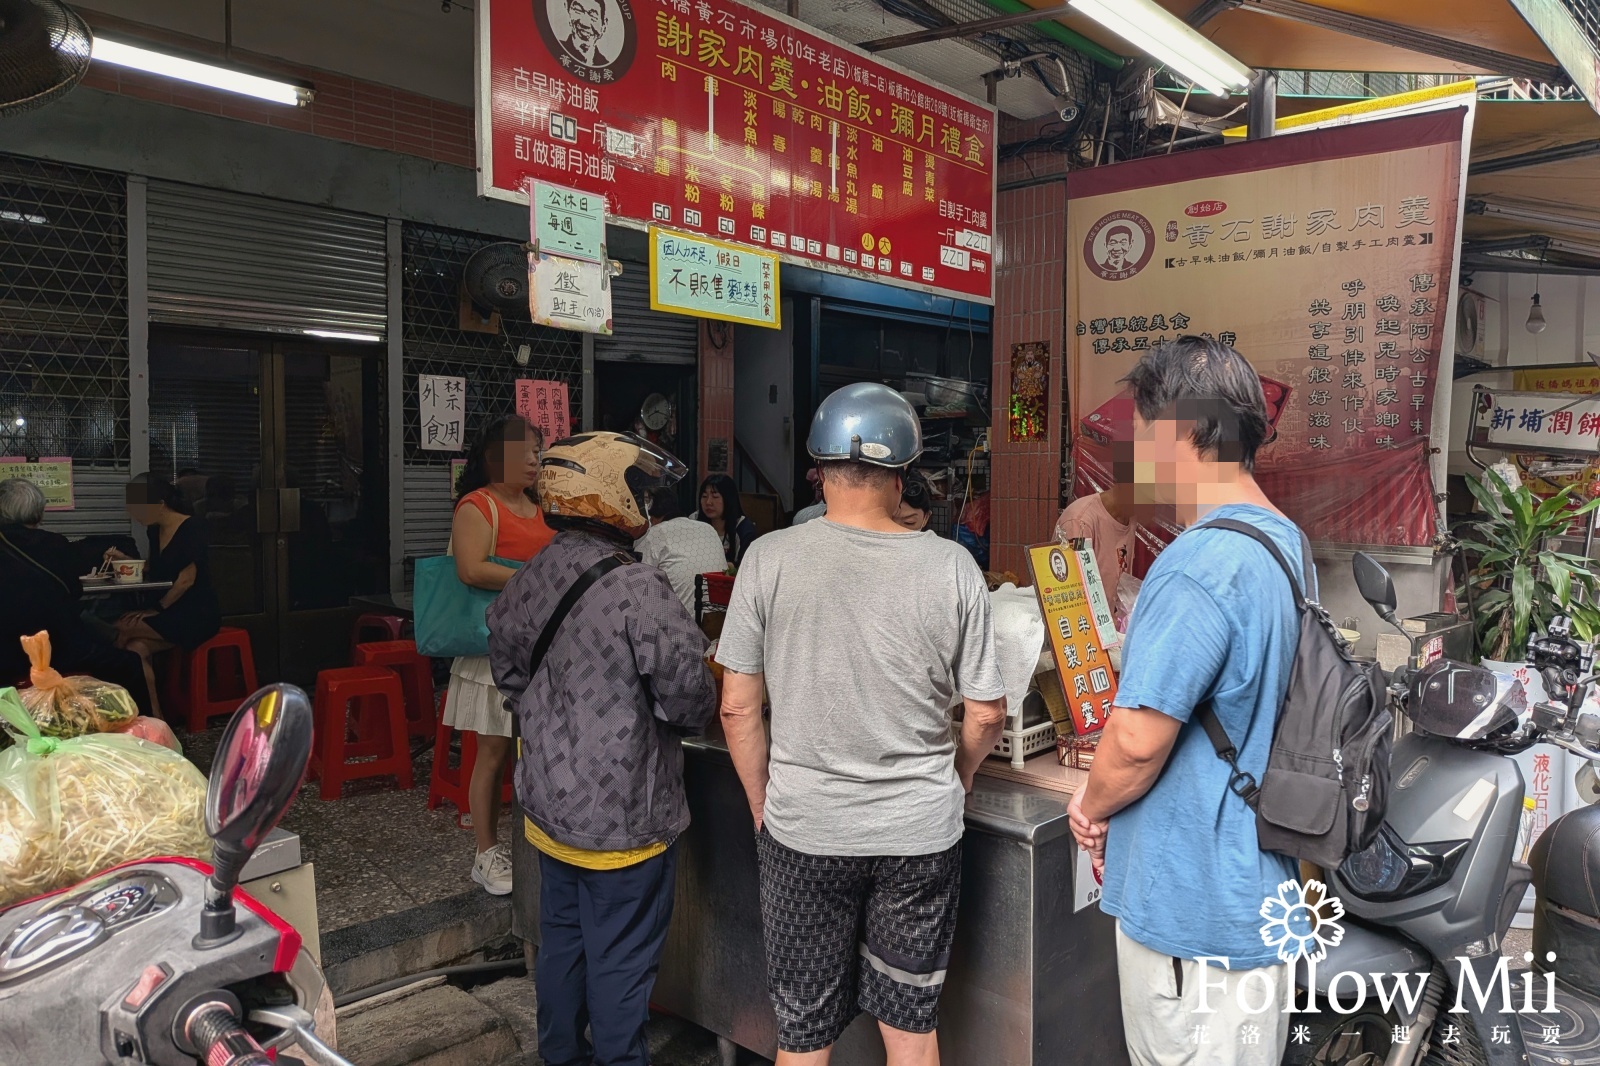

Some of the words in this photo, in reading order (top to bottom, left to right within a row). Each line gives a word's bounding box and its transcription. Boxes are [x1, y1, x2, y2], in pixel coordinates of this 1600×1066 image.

[512, 67, 600, 114] 古早味油飯
[559, 54, 614, 83] 黃石謝家
[513, 135, 616, 183] 訂做彌月油飯
[845, 126, 859, 215] 淡水魚丸湯
[871, 135, 884, 201] 油飯
[902, 147, 914, 197] 油豆腐
[924, 153, 936, 203] 燙青菜
[549, 190, 588, 212] 公休日
[684, 164, 701, 204] 米粉
[547, 212, 578, 236] 每週
[938, 199, 988, 229] 自製手工肉羹
[1099, 213, 1121, 227] HOUSE
[1121, 212, 1140, 221] MEAT
[1138, 218, 1152, 234] SOUP
[1165, 220, 1178, 241] 板橋
[1186, 201, 1224, 215] 創始店
[654, 205, 671, 220] 60
[685, 211, 700, 226] 60
[719, 218, 734, 233] 60
[751, 226, 765, 241] 60
[844, 248, 857, 262] 60
[862, 253, 874, 267] 40
[901, 263, 912, 275] 20
[862, 234, 874, 248] 小
[880, 239, 891, 253] 大
[941, 247, 964, 267] 220
[965, 231, 987, 251] 220
[761, 261, 772, 317] 禁用外食
[1076, 312, 1191, 336] 台灣傳統美食
[1308, 299, 1332, 450] 共享這般好滋味
[1341, 278, 1366, 434] 呼朋引伴來作伙
[1375, 294, 1402, 450] 喚起兒時家鄉味
[1409, 273, 1436, 434] 傳承阿公古早味
[422, 379, 446, 446] 外食
[443, 380, 464, 445] 禁用
[1057, 615, 1099, 729] 自製肉羹
